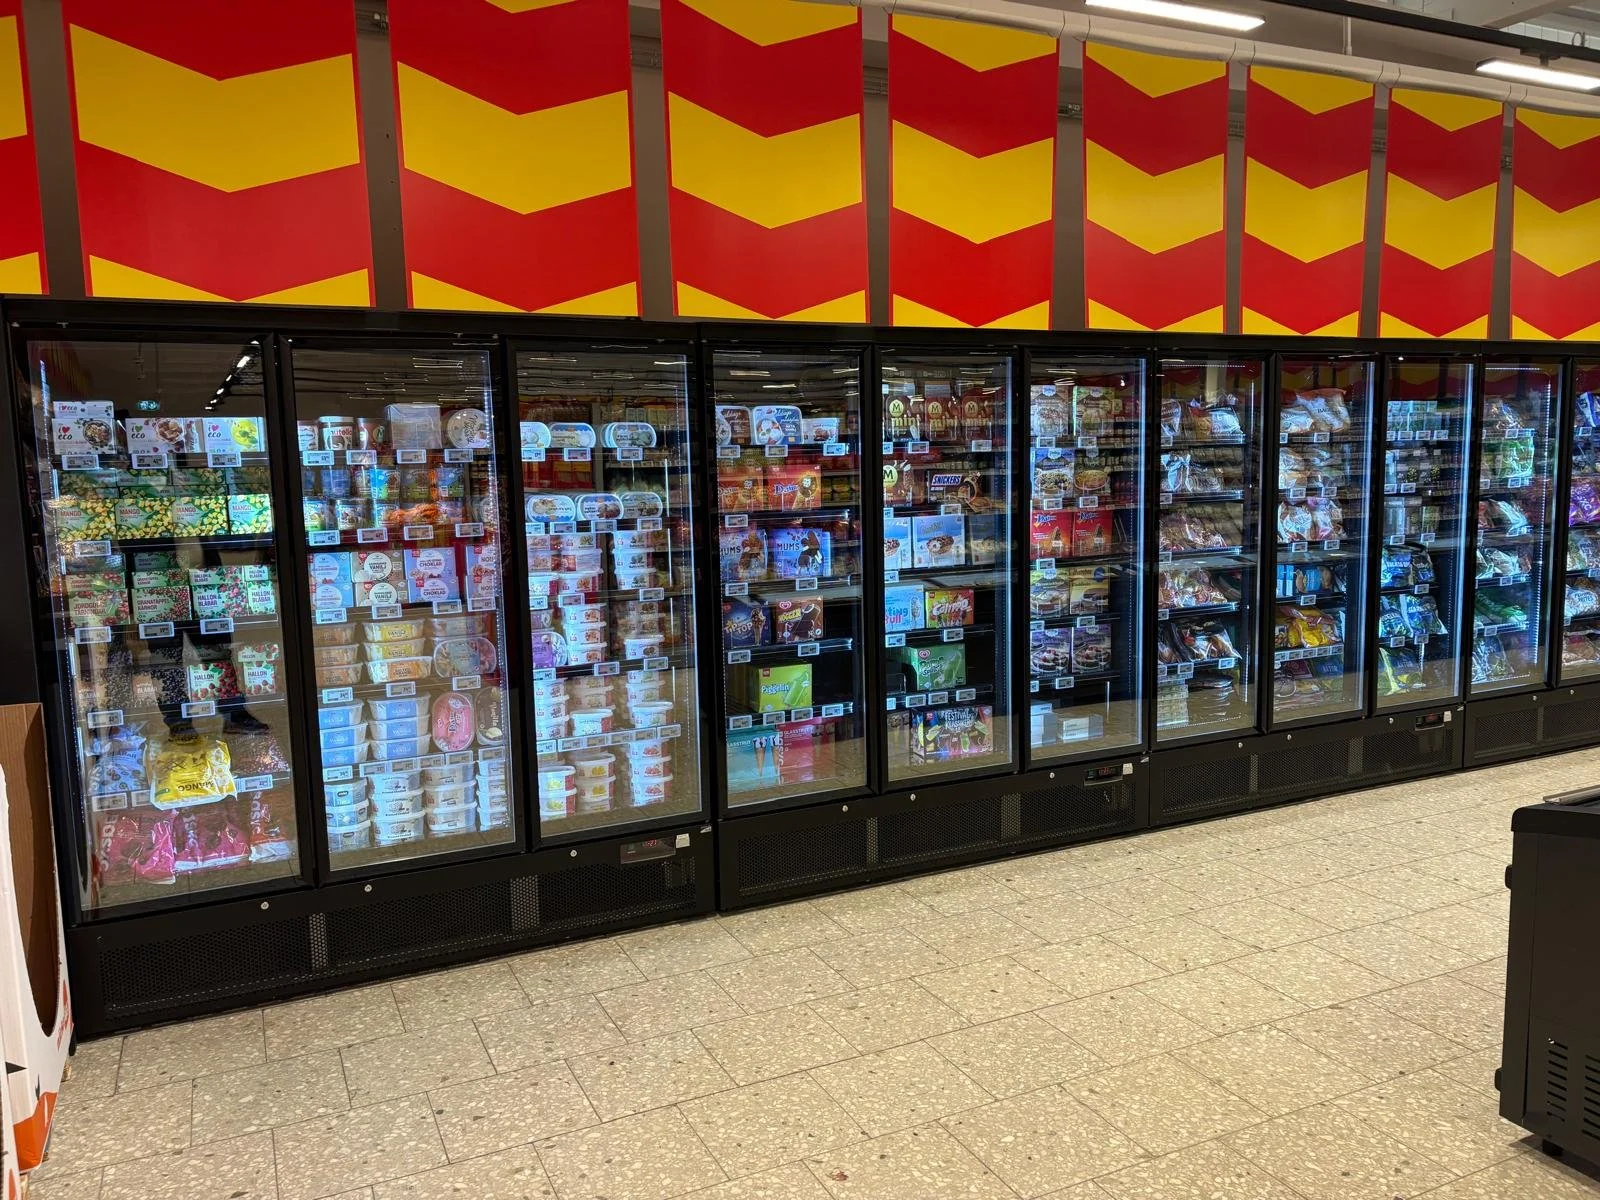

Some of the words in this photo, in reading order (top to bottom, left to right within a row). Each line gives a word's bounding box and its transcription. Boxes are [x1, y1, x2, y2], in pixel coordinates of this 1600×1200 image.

[891, 403, 901, 411] M
[883, 470, 894, 479] M
[933, 475, 962, 484] SNICKERS
[777, 543, 800, 552] MUMS
[737, 621, 753, 634] TOP
